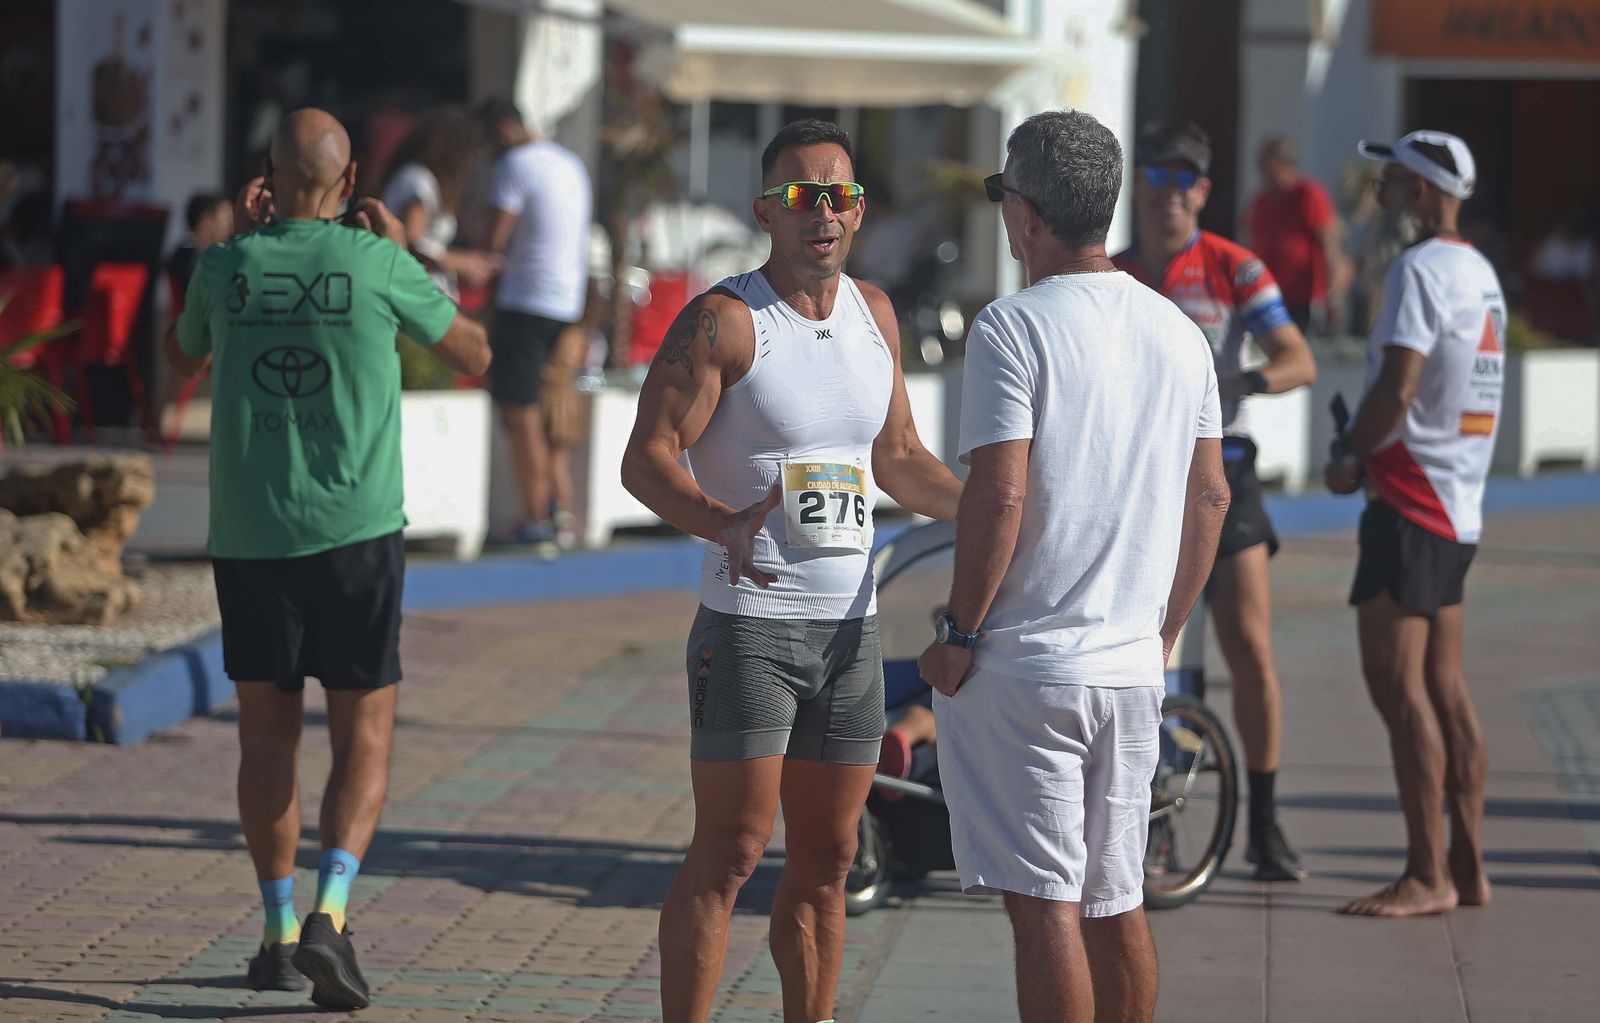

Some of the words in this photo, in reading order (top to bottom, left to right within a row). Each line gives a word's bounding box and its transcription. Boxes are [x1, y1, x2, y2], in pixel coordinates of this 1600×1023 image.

[262, 272, 352, 314] EXO
[252, 412, 333, 432] TOMAX
[806, 465, 821, 473] XXIII
[807, 481, 831, 489] CIUDAD
[798, 491, 865, 528] 276
[694, 677, 708, 728] BIONIC
